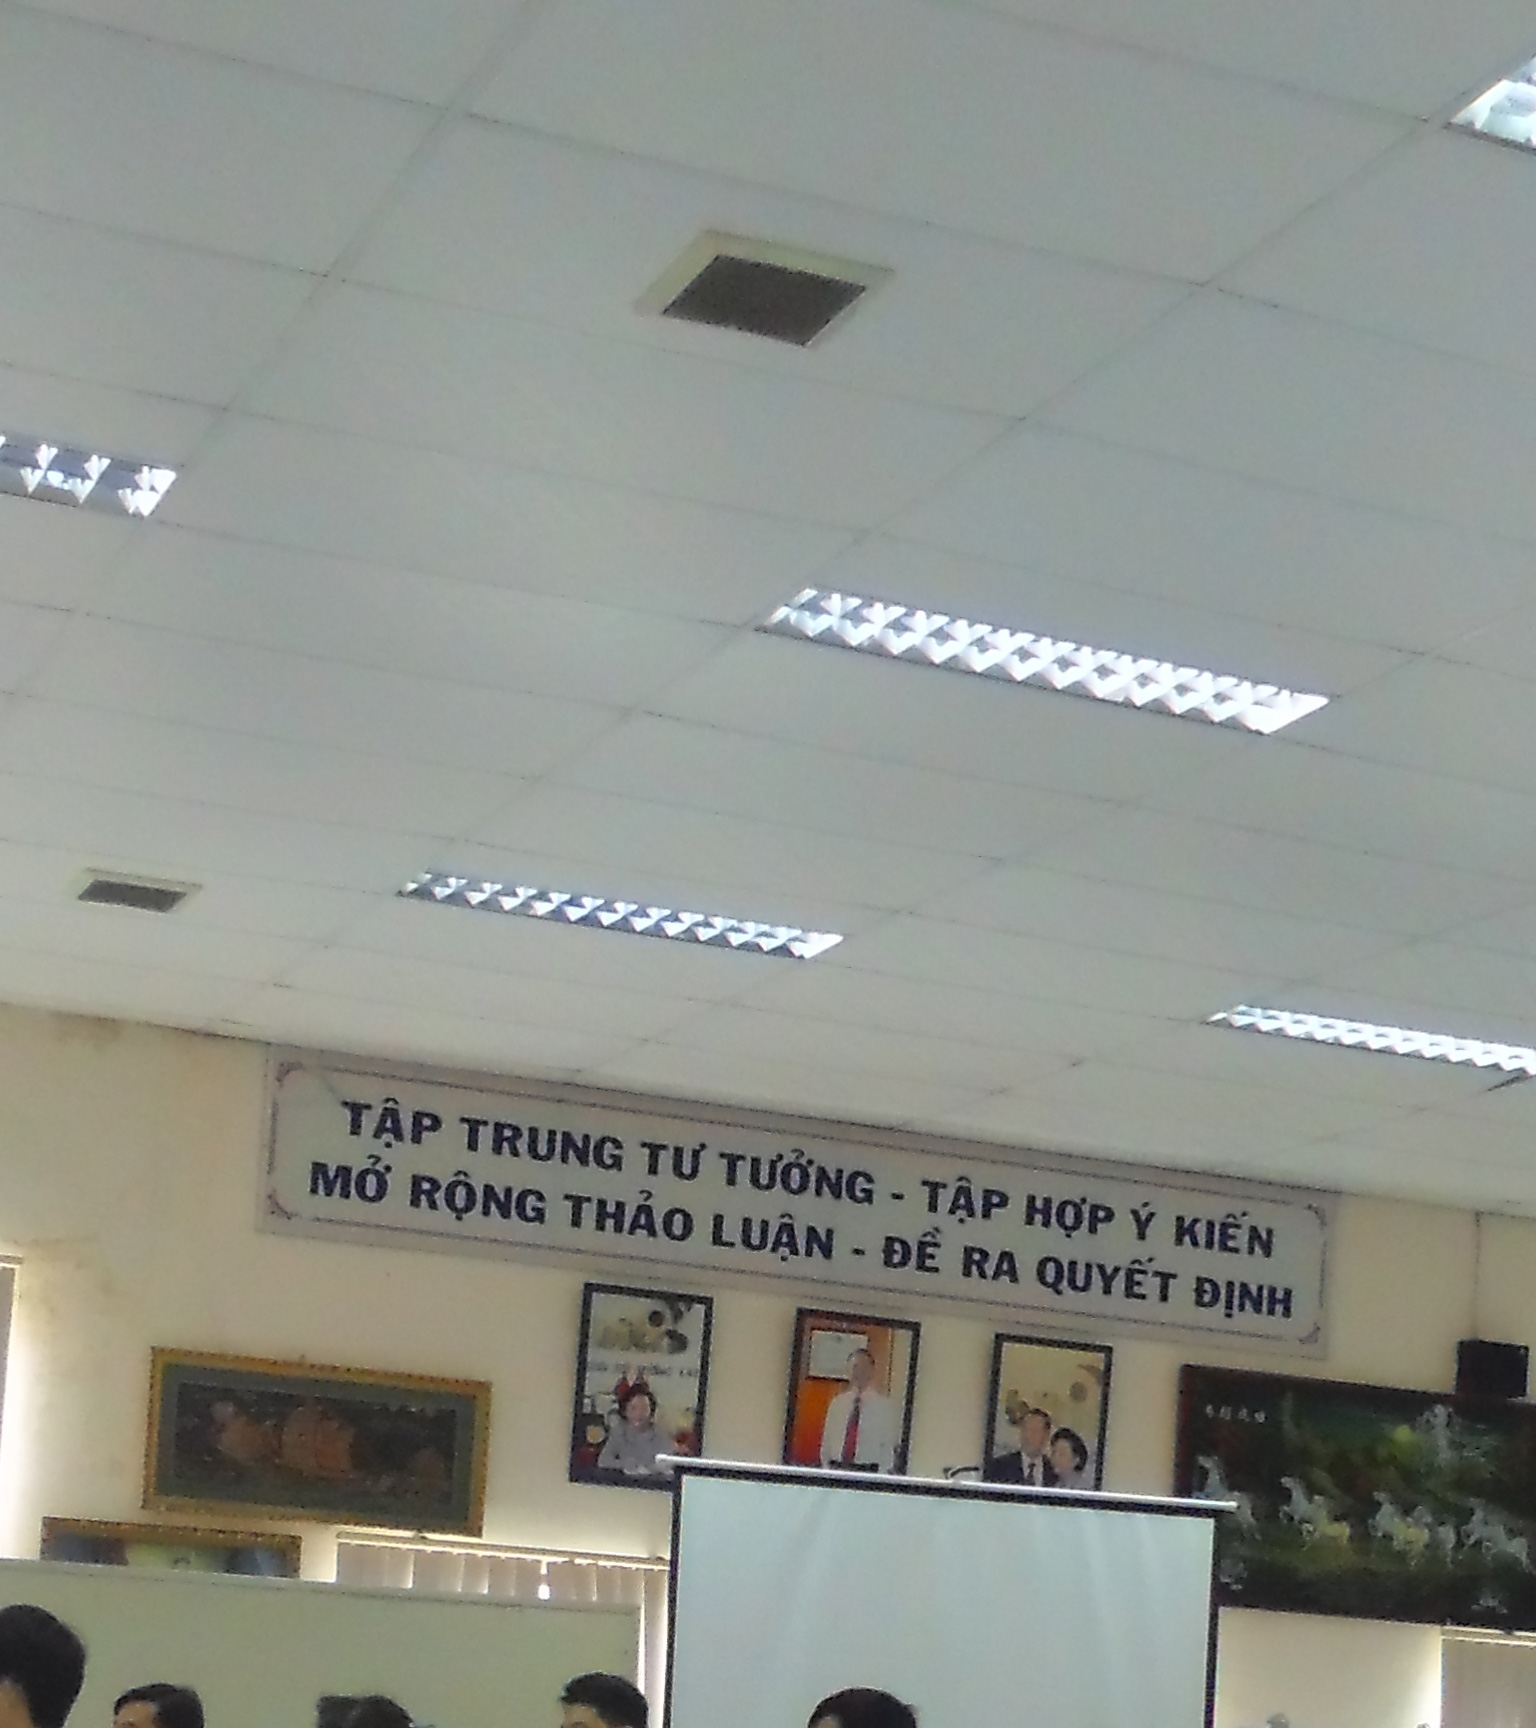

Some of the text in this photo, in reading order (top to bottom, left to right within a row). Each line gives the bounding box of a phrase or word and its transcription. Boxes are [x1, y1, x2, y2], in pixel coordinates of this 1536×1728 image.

[309, 1154, 393, 1203] MỞ
[409, 1169, 547, 1226] RỘNG
[563, 1189, 695, 1242] THẢO
[712, 1212, 835, 1262] LUẬN
[881, 1225, 943, 1274] ĐỀ
[962, 1245, 1020, 1285] RA
[1035, 1256, 1178, 1304] QUYẾT
[1194, 1274, 1294, 1319] ĐỊNH
[341, 1097, 443, 1149] TẬP
[460, 1116, 624, 1172] TRUNG
[640, 1141, 707, 1182] TƯ
[719, 1148, 875, 1206] TƯỞNG
[921, 1175, 1010, 1224] TẬP
[1024, 1194, 1116, 1239] HỢP
[1130, 1200, 1156, 1241] Ý
[1174, 1211, 1275, 1258] KIẾN
